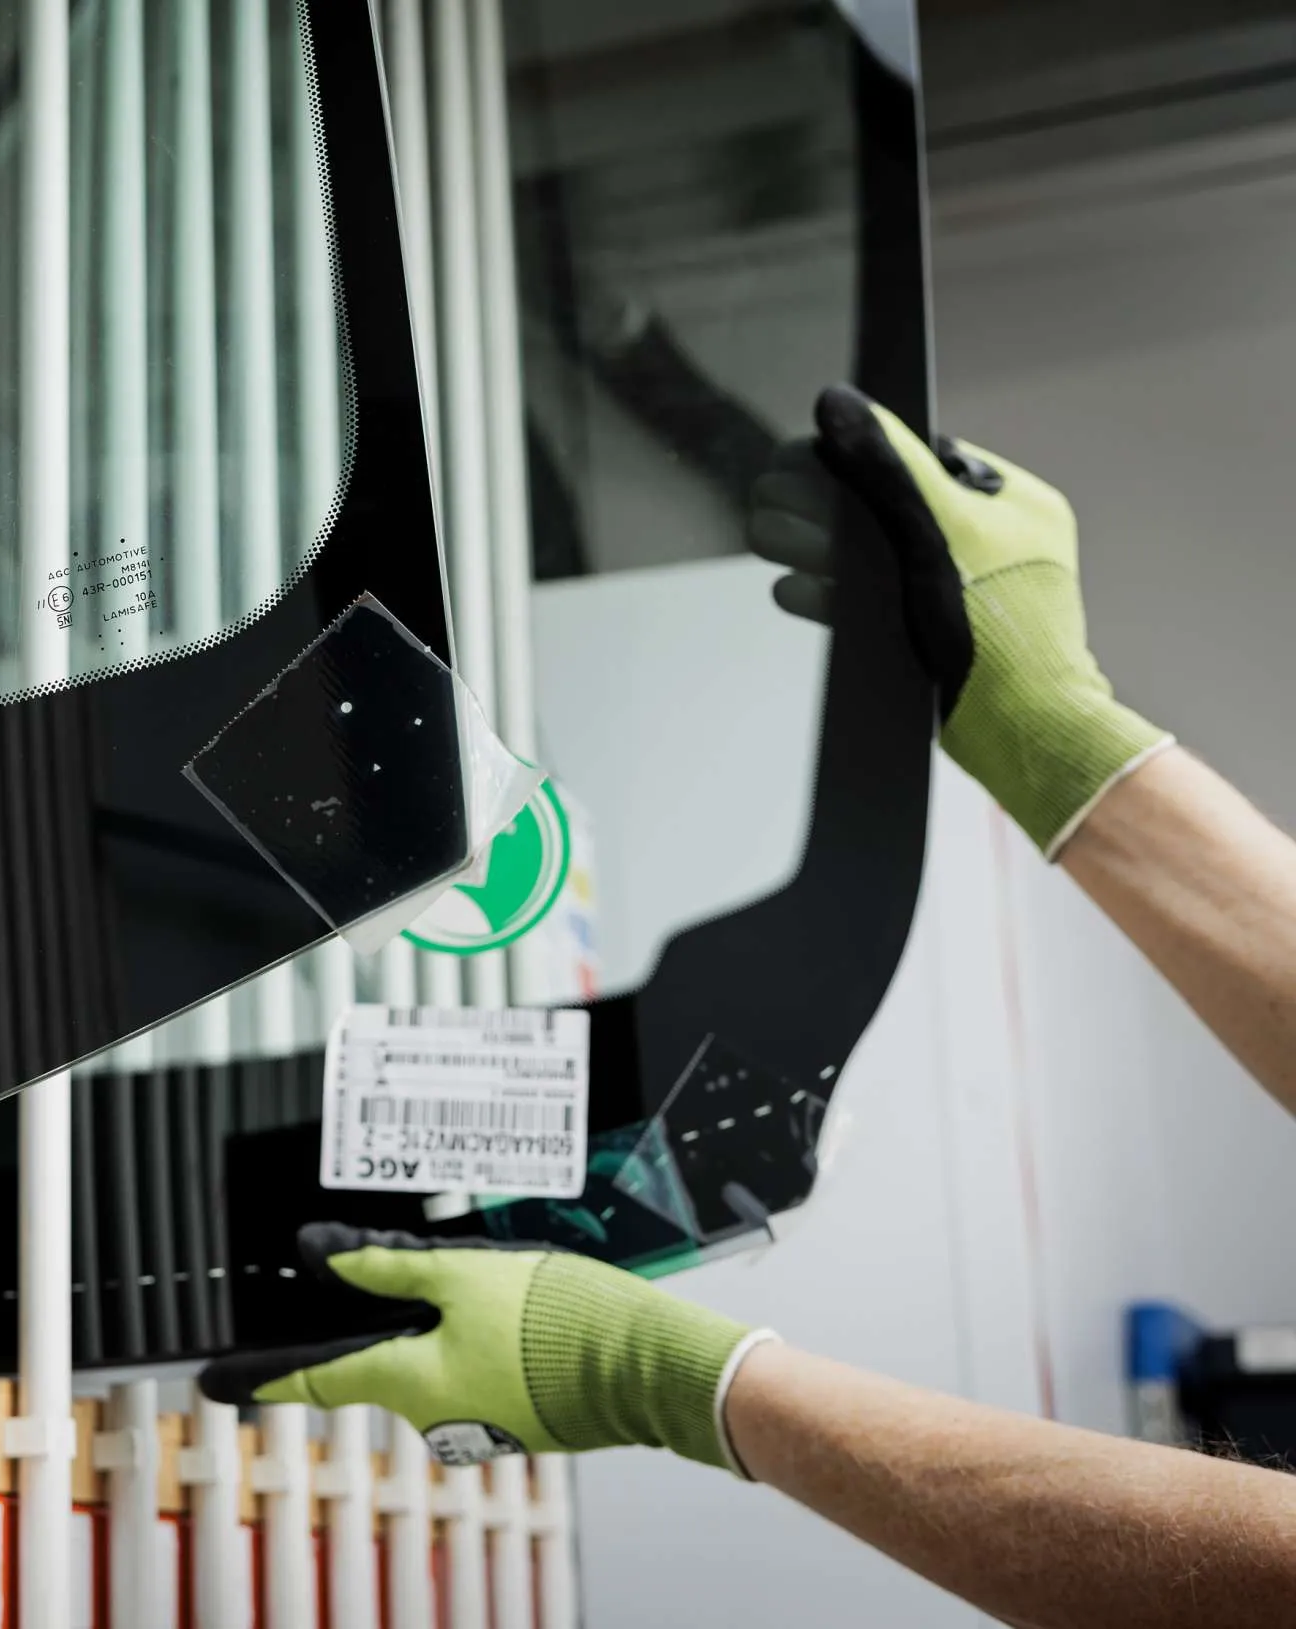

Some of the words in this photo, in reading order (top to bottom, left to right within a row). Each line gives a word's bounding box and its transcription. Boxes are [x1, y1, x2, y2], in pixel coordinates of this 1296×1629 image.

[48, 568, 71, 580] AGC
[77, 545, 147, 572] AUTOMOTIVE
[82, 569, 152, 597] 43R-000151
[135, 591, 156, 602] 10A
[103, 600, 158, 622] LAMISAFE
[358, 1158, 420, 1181] AGC
